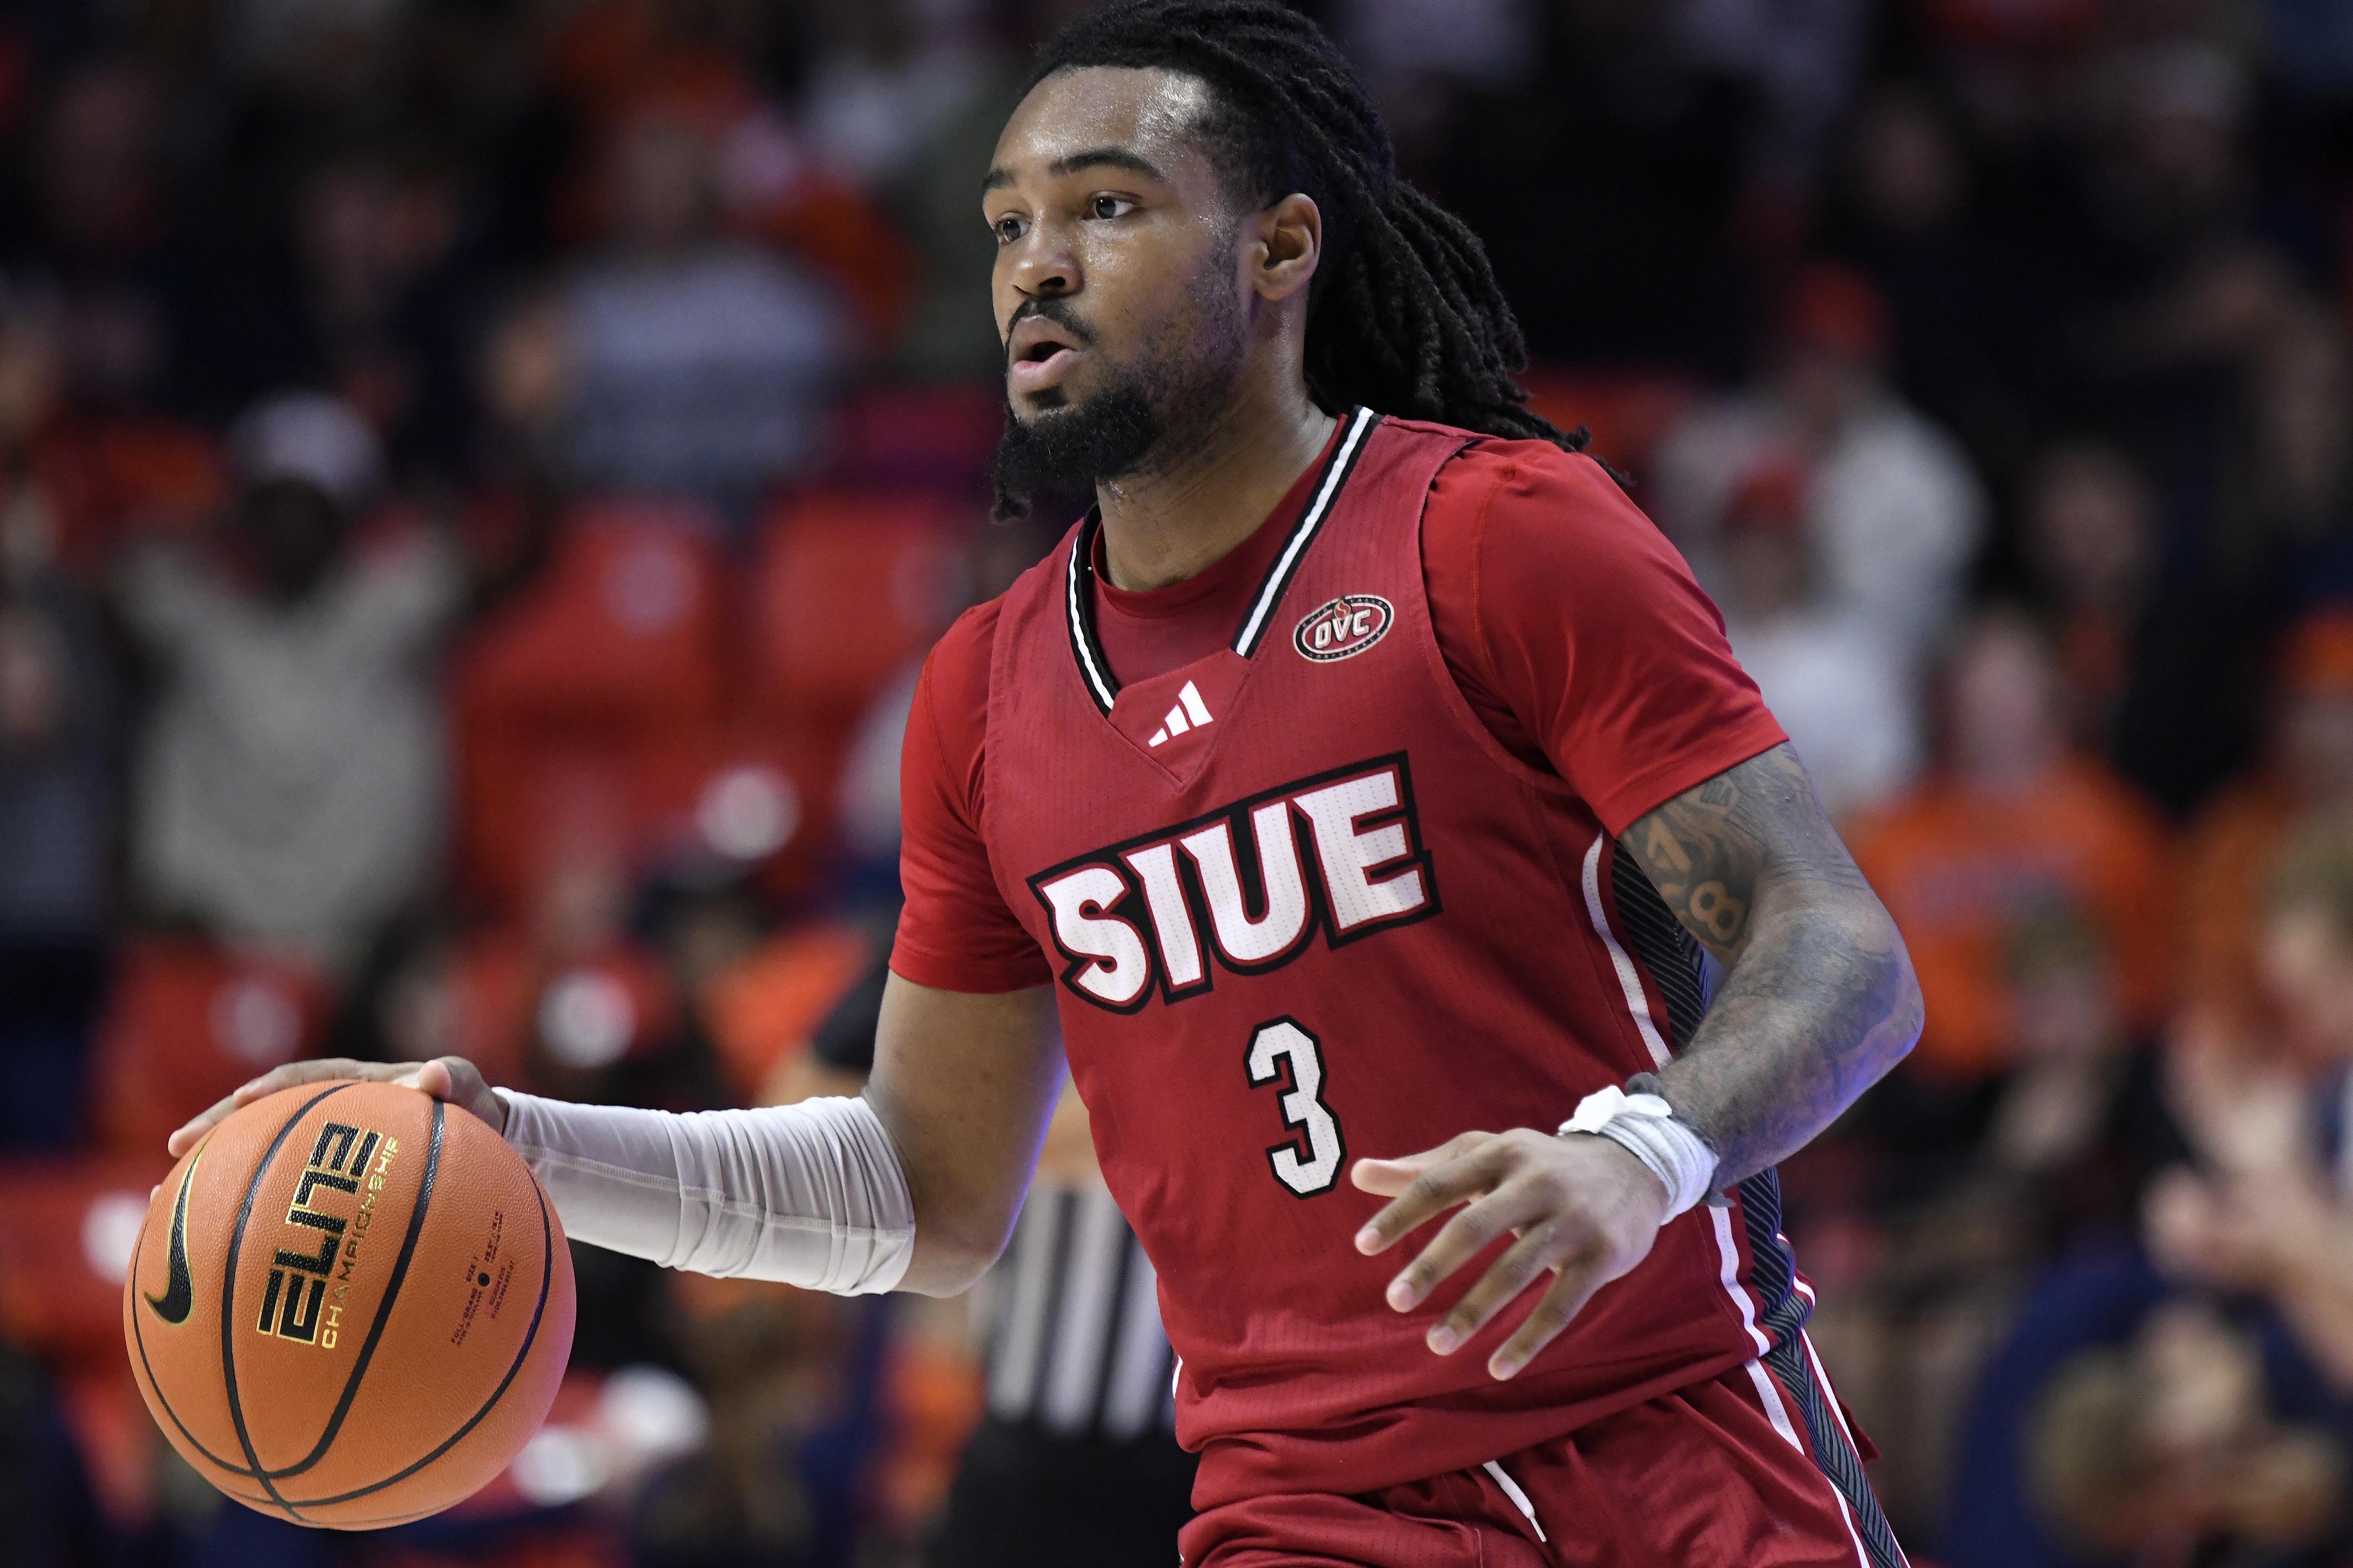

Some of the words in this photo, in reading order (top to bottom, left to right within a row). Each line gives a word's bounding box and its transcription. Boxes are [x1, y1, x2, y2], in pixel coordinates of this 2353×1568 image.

[1314, 608, 1371, 649] OVC
[1031, 755, 1438, 1011] SIUE
[1245, 1016, 1346, 1199] 3
[257, 1121, 382, 1345] ELITE
[321, 1136, 398, 1349] CHAMPIONSHIP
[465, 1263, 477, 1283] SIZE
